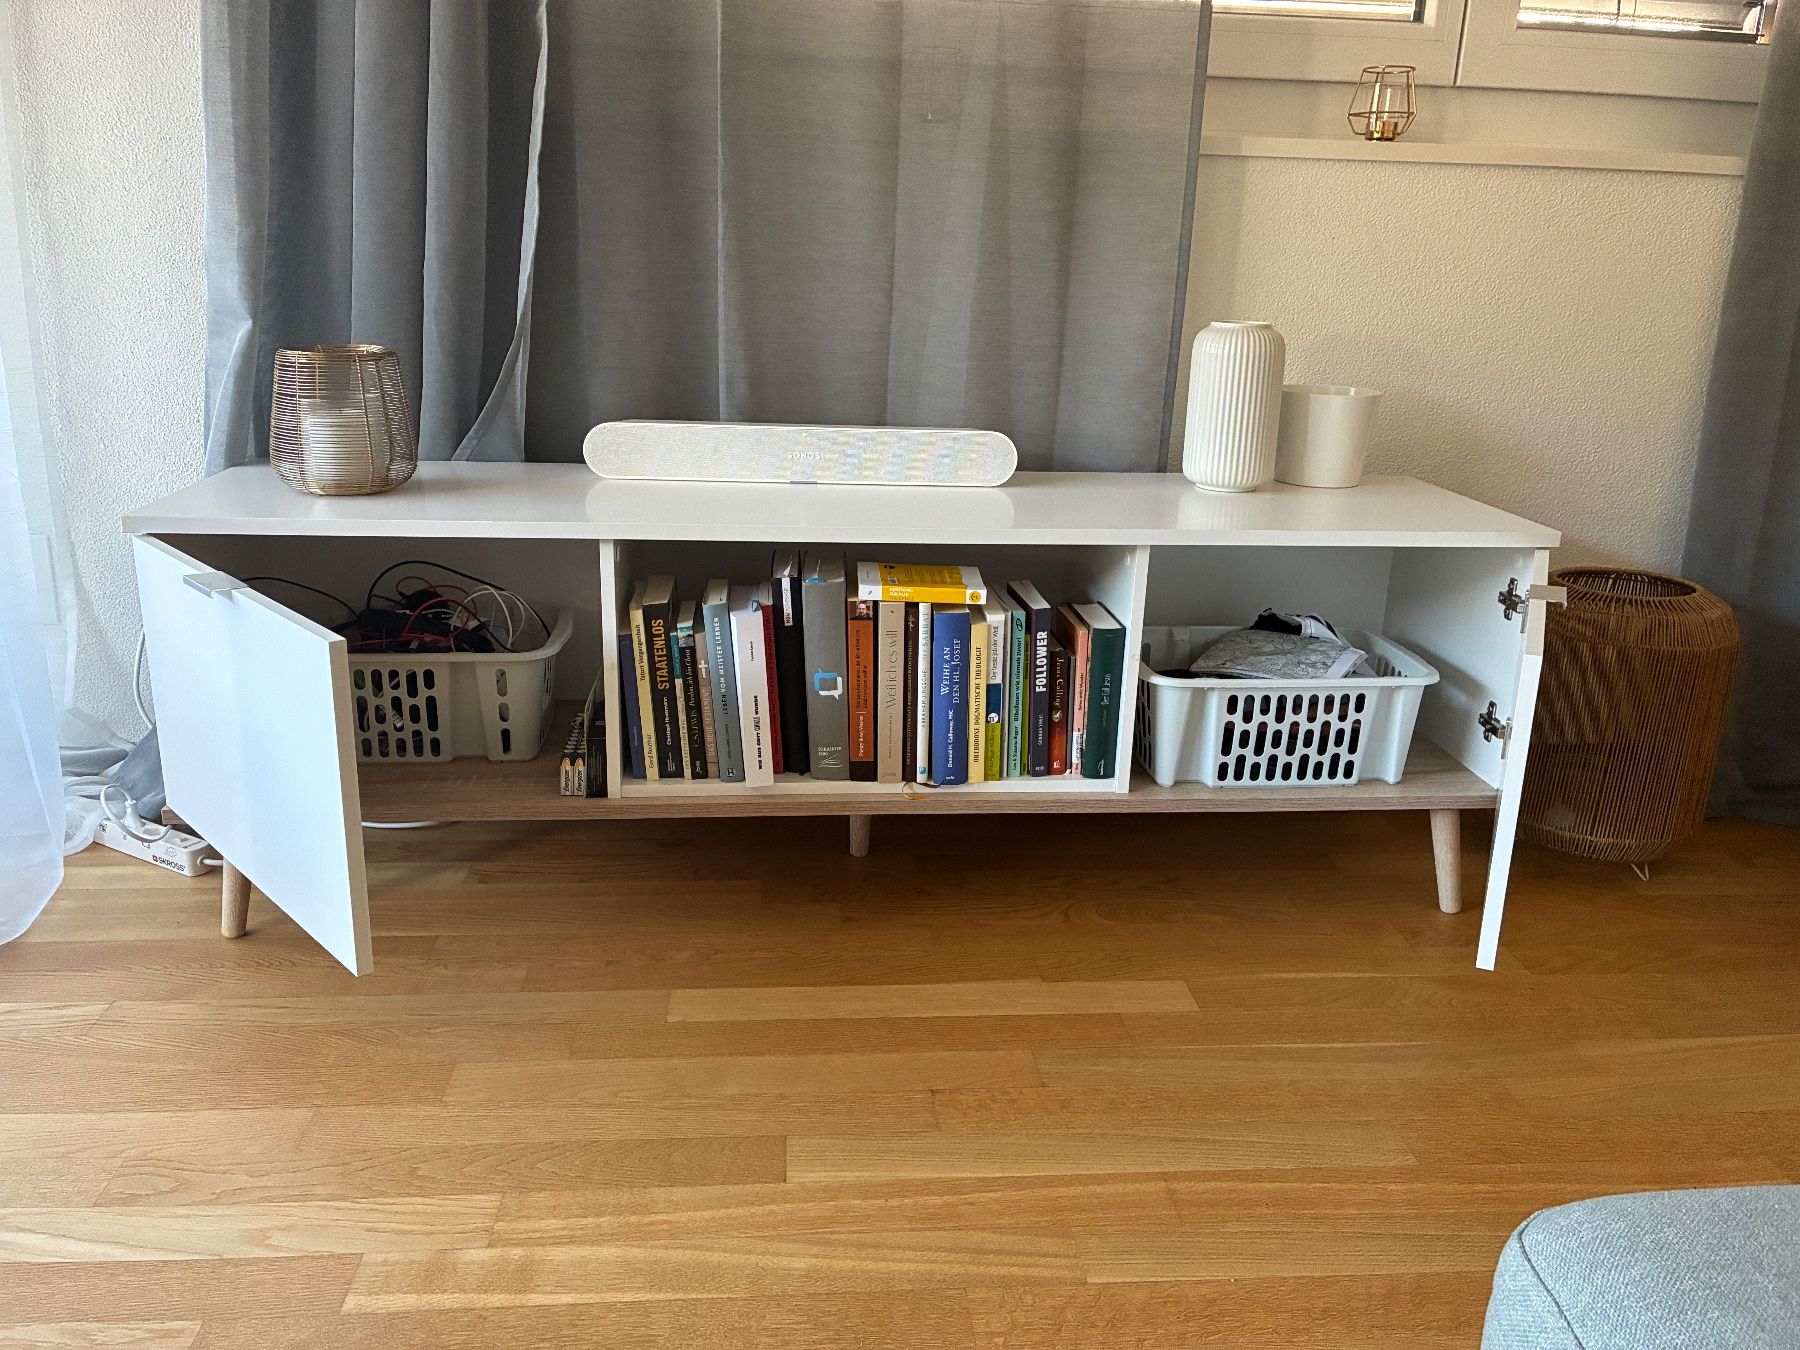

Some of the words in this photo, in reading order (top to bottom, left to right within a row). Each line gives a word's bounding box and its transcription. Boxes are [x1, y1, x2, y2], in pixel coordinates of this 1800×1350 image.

[788, 451, 820, 459] SONOS
[714, 617, 722, 644] LERNEN
[886, 630, 898, 648] will
[652, 619, 670, 689] STAATENLOS
[716, 645, 724, 675] MEISTER
[888, 650, 898, 664] es
[944, 646, 950, 660] AN
[950, 638, 962, 666] JOSEF
[1036, 630, 1048, 692] FOLLOWER
[885, 666, 897, 682] ich
[940, 662, 950, 695] WEIHE
[1056, 658, 1064, 678] Jesus
[885, 684, 897, 708] Weil
[1054, 678, 1064, 706] Calling
[702, 689, 712, 724] TESTAMENT
[158, 857, 185, 872] SKROSS
